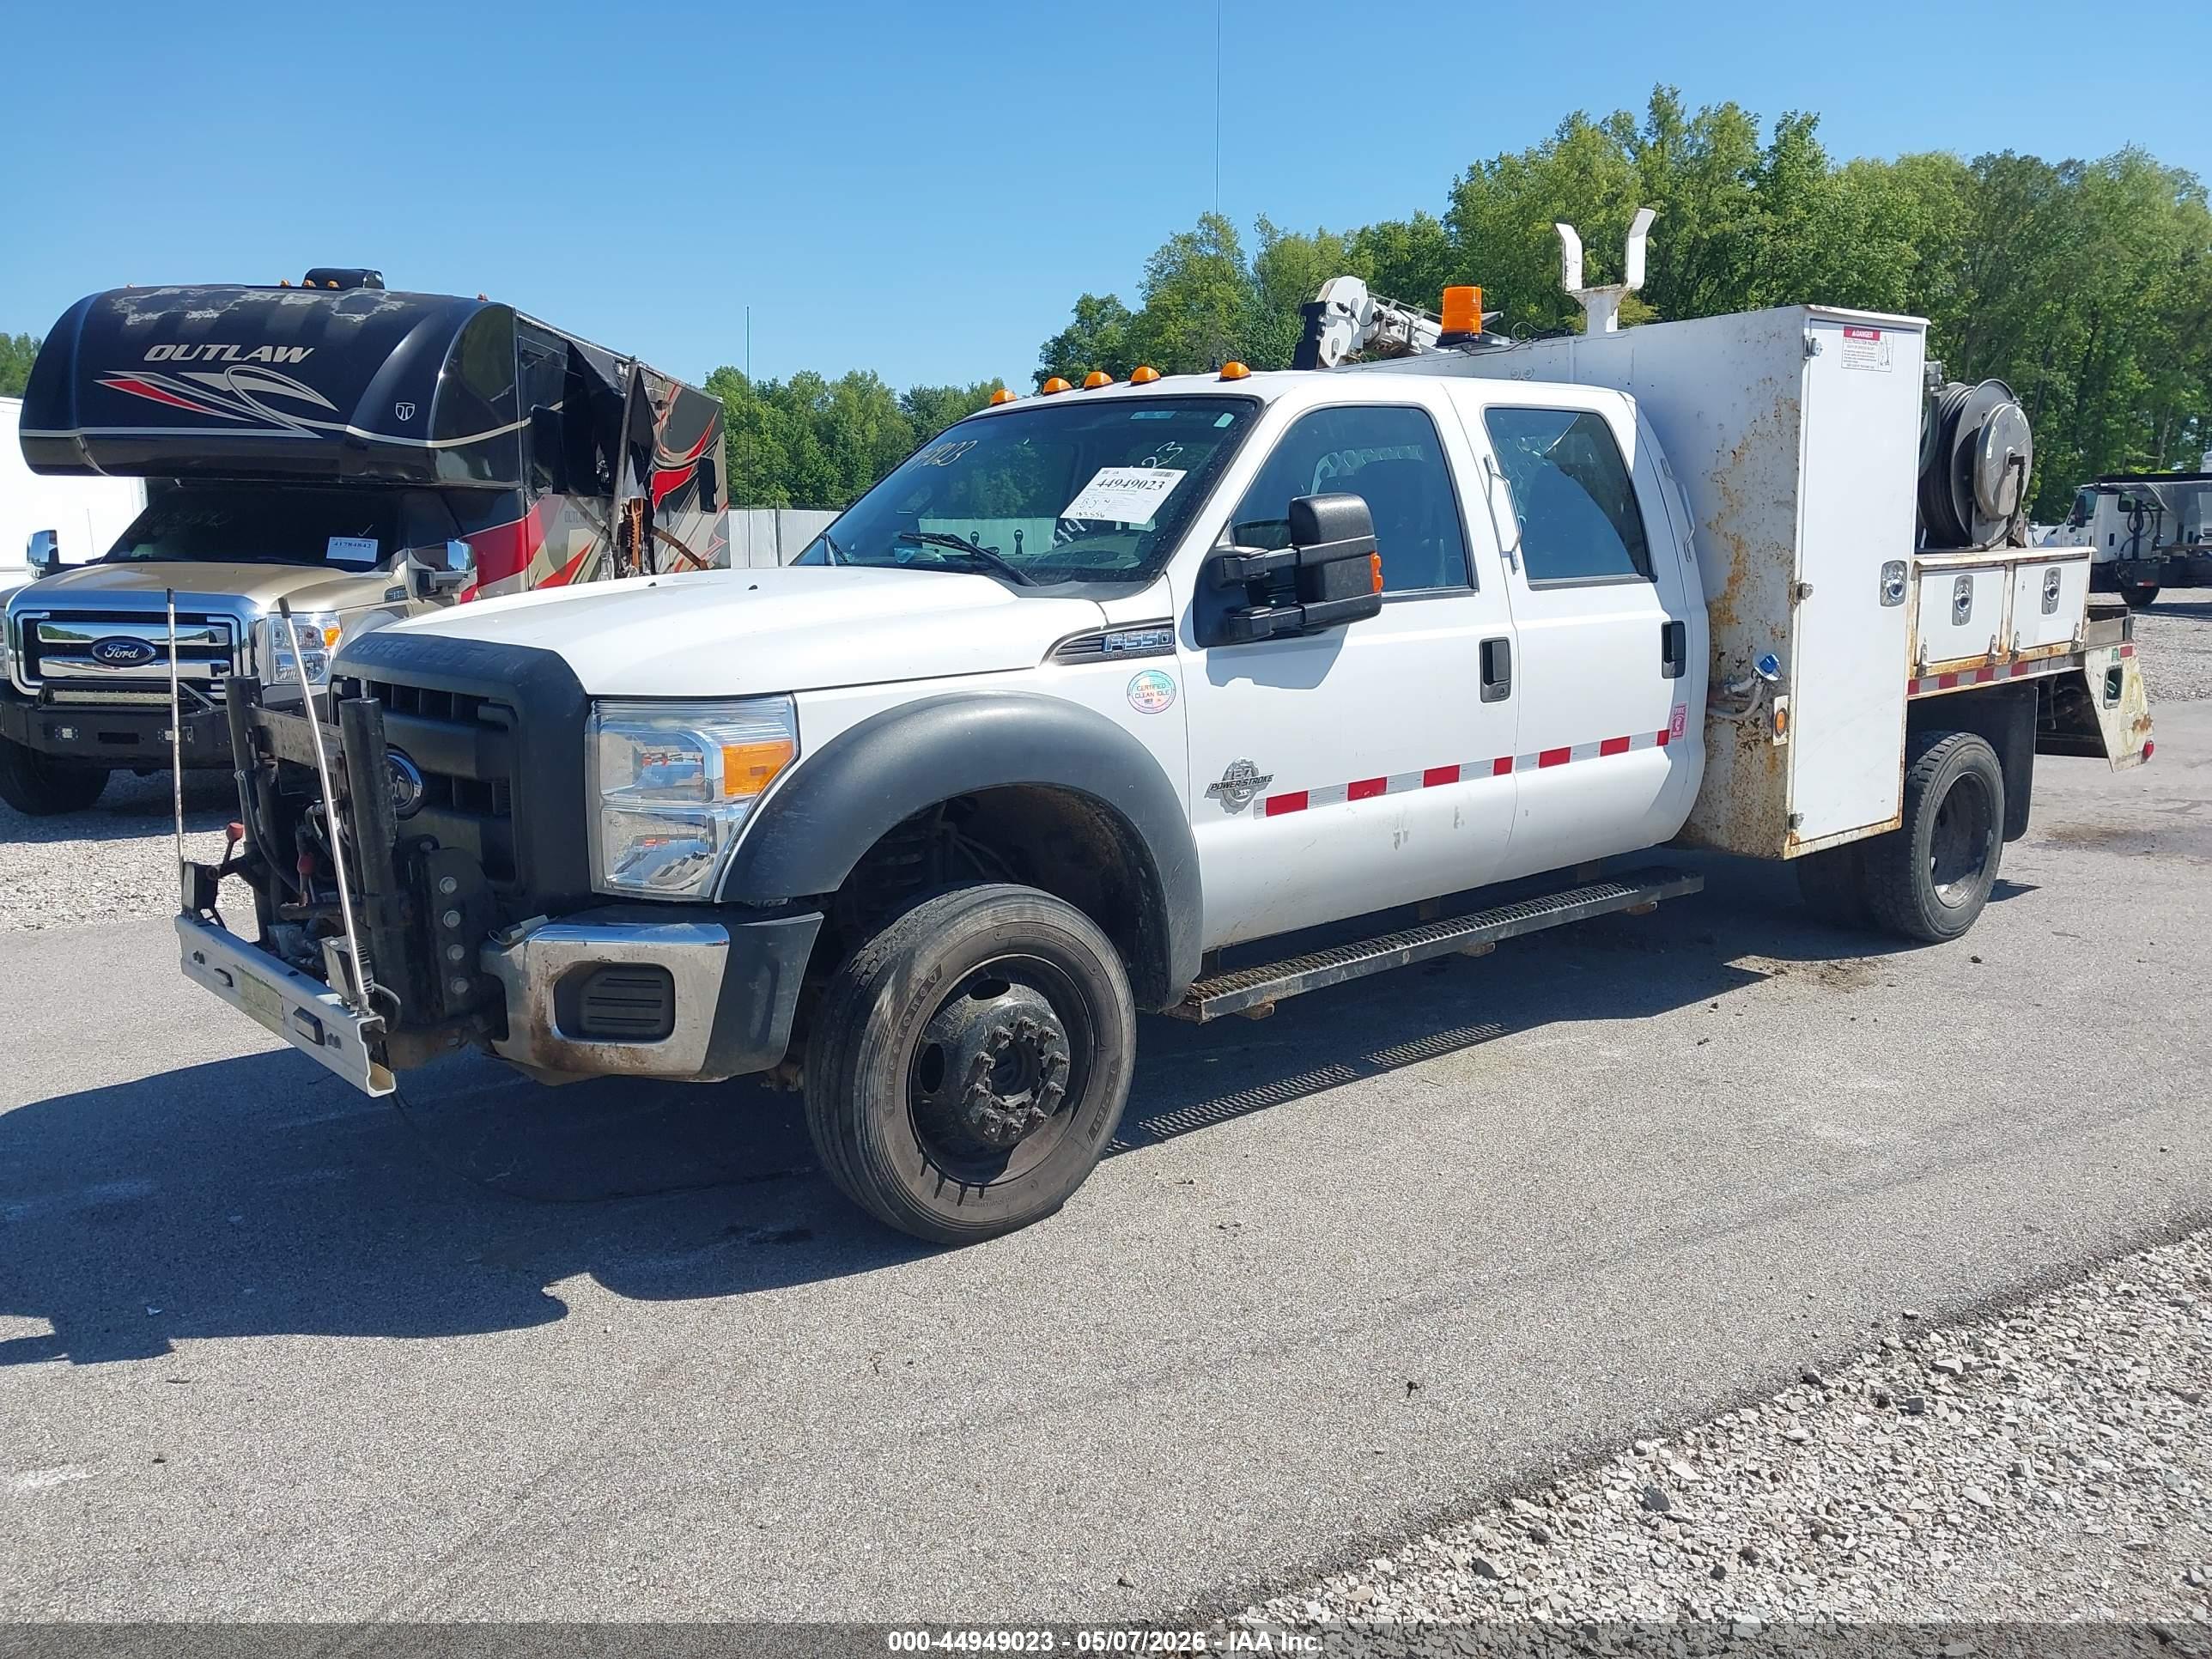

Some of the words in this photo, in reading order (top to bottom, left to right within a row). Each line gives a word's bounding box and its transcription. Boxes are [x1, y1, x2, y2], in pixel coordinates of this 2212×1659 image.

[144, 343, 315, 363] OUTLAW
[1096, 478, 1165, 491] 44949023
[104, 643, 138, 659] Ford
[1104, 631, 1174, 653] F-550
